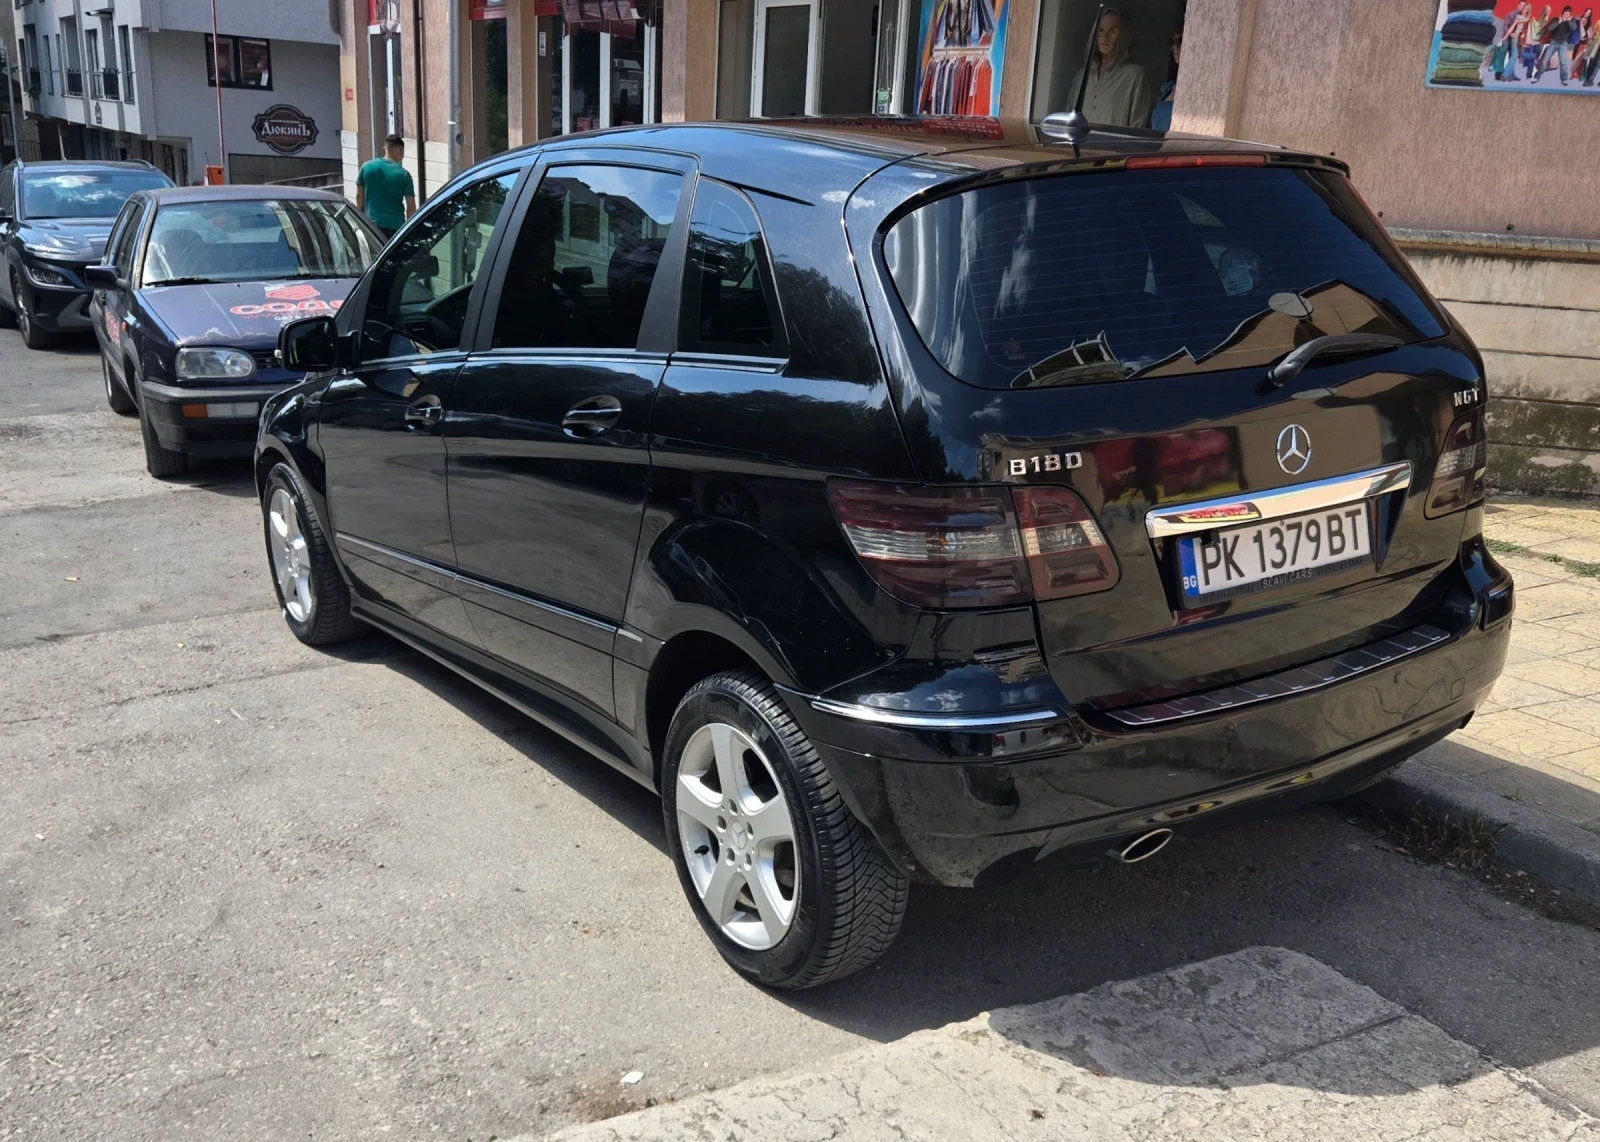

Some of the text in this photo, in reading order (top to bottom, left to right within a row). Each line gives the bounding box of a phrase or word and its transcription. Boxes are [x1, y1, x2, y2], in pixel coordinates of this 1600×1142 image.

[1453, 388, 1480, 407] NGT
[1253, 519, 1321, 573] 1379
[1326, 508, 1362, 556] BT
[1183, 575, 1198, 590] BG
